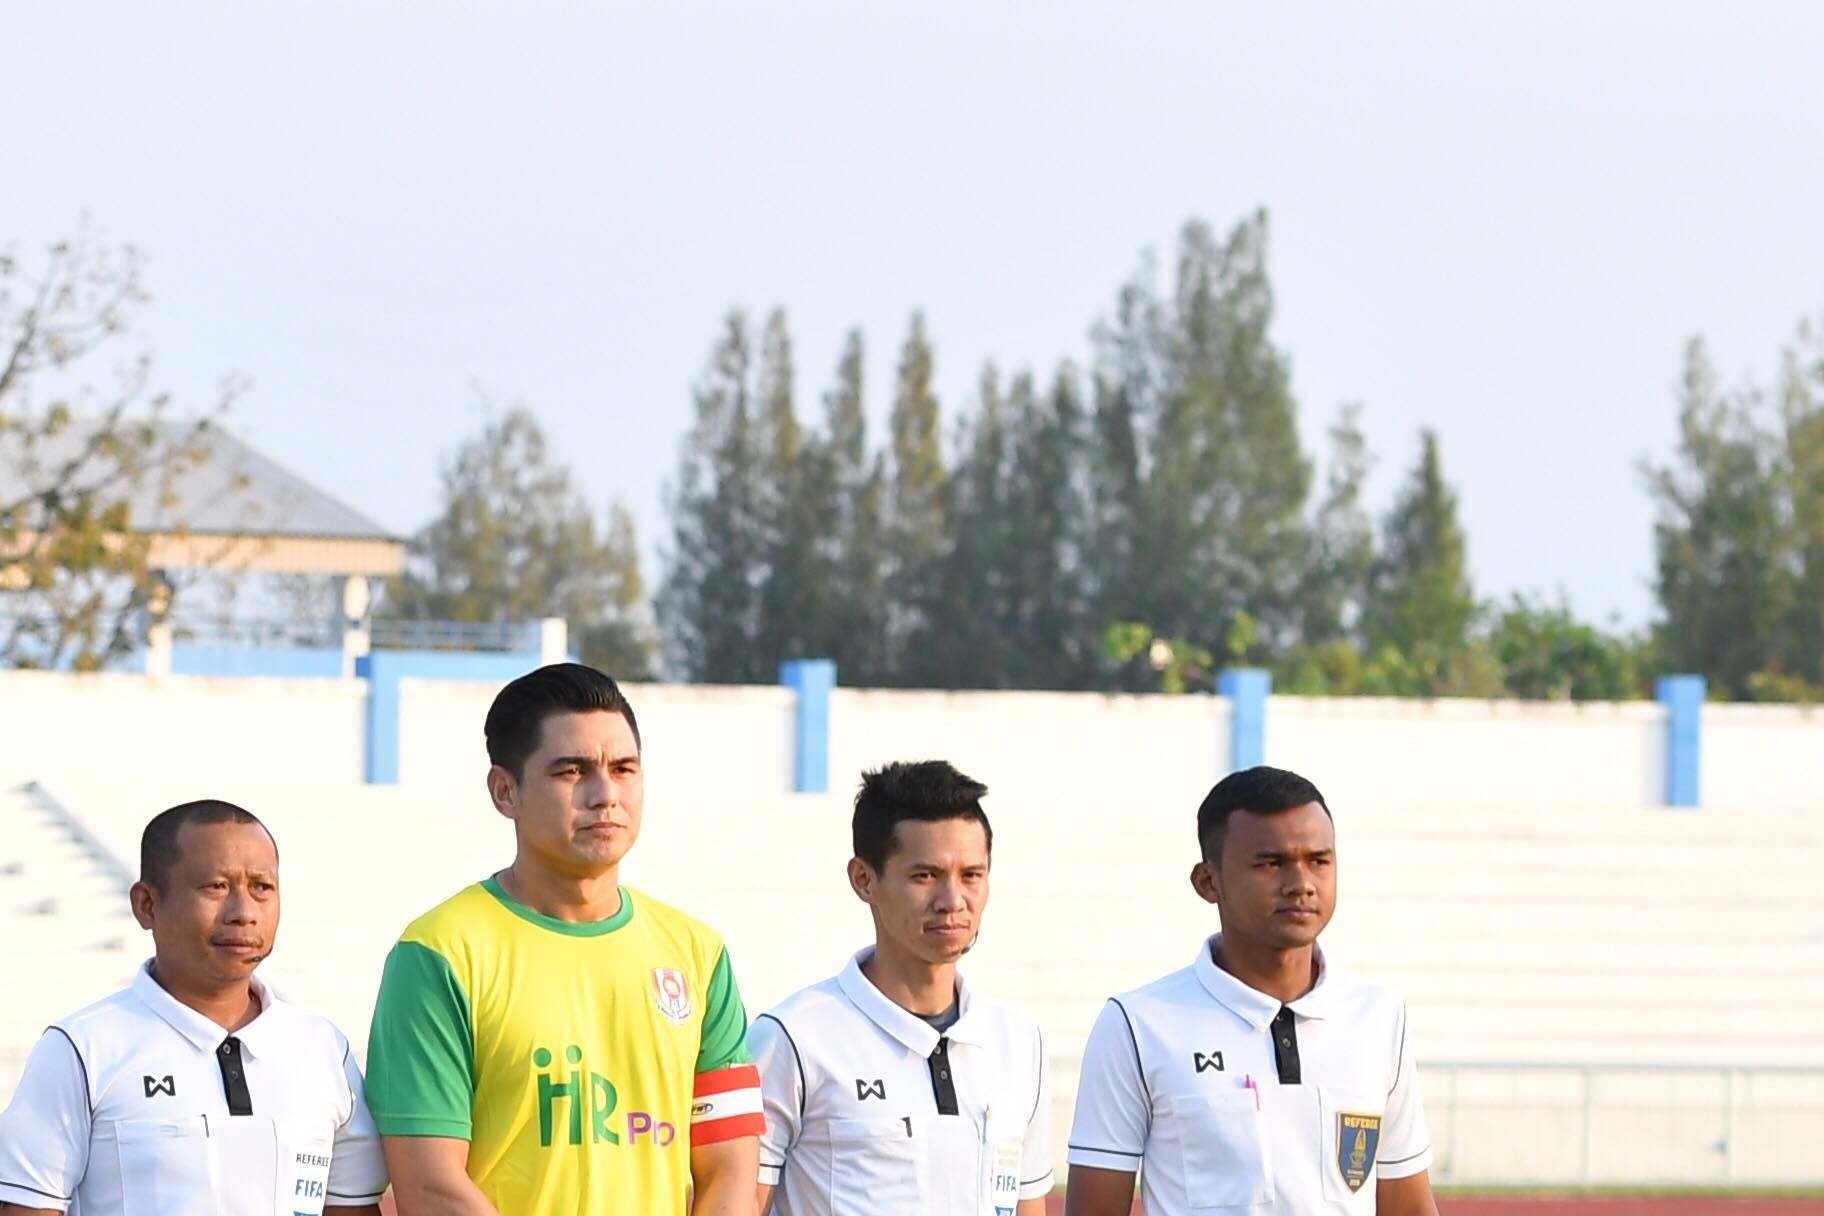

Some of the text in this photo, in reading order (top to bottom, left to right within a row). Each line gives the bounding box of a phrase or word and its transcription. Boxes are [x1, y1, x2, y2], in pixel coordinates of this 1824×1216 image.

[296, 1153, 329, 1167] REFEREE
[295, 1179, 323, 1198] FIFA
[995, 1174, 1017, 1192] FIFA
